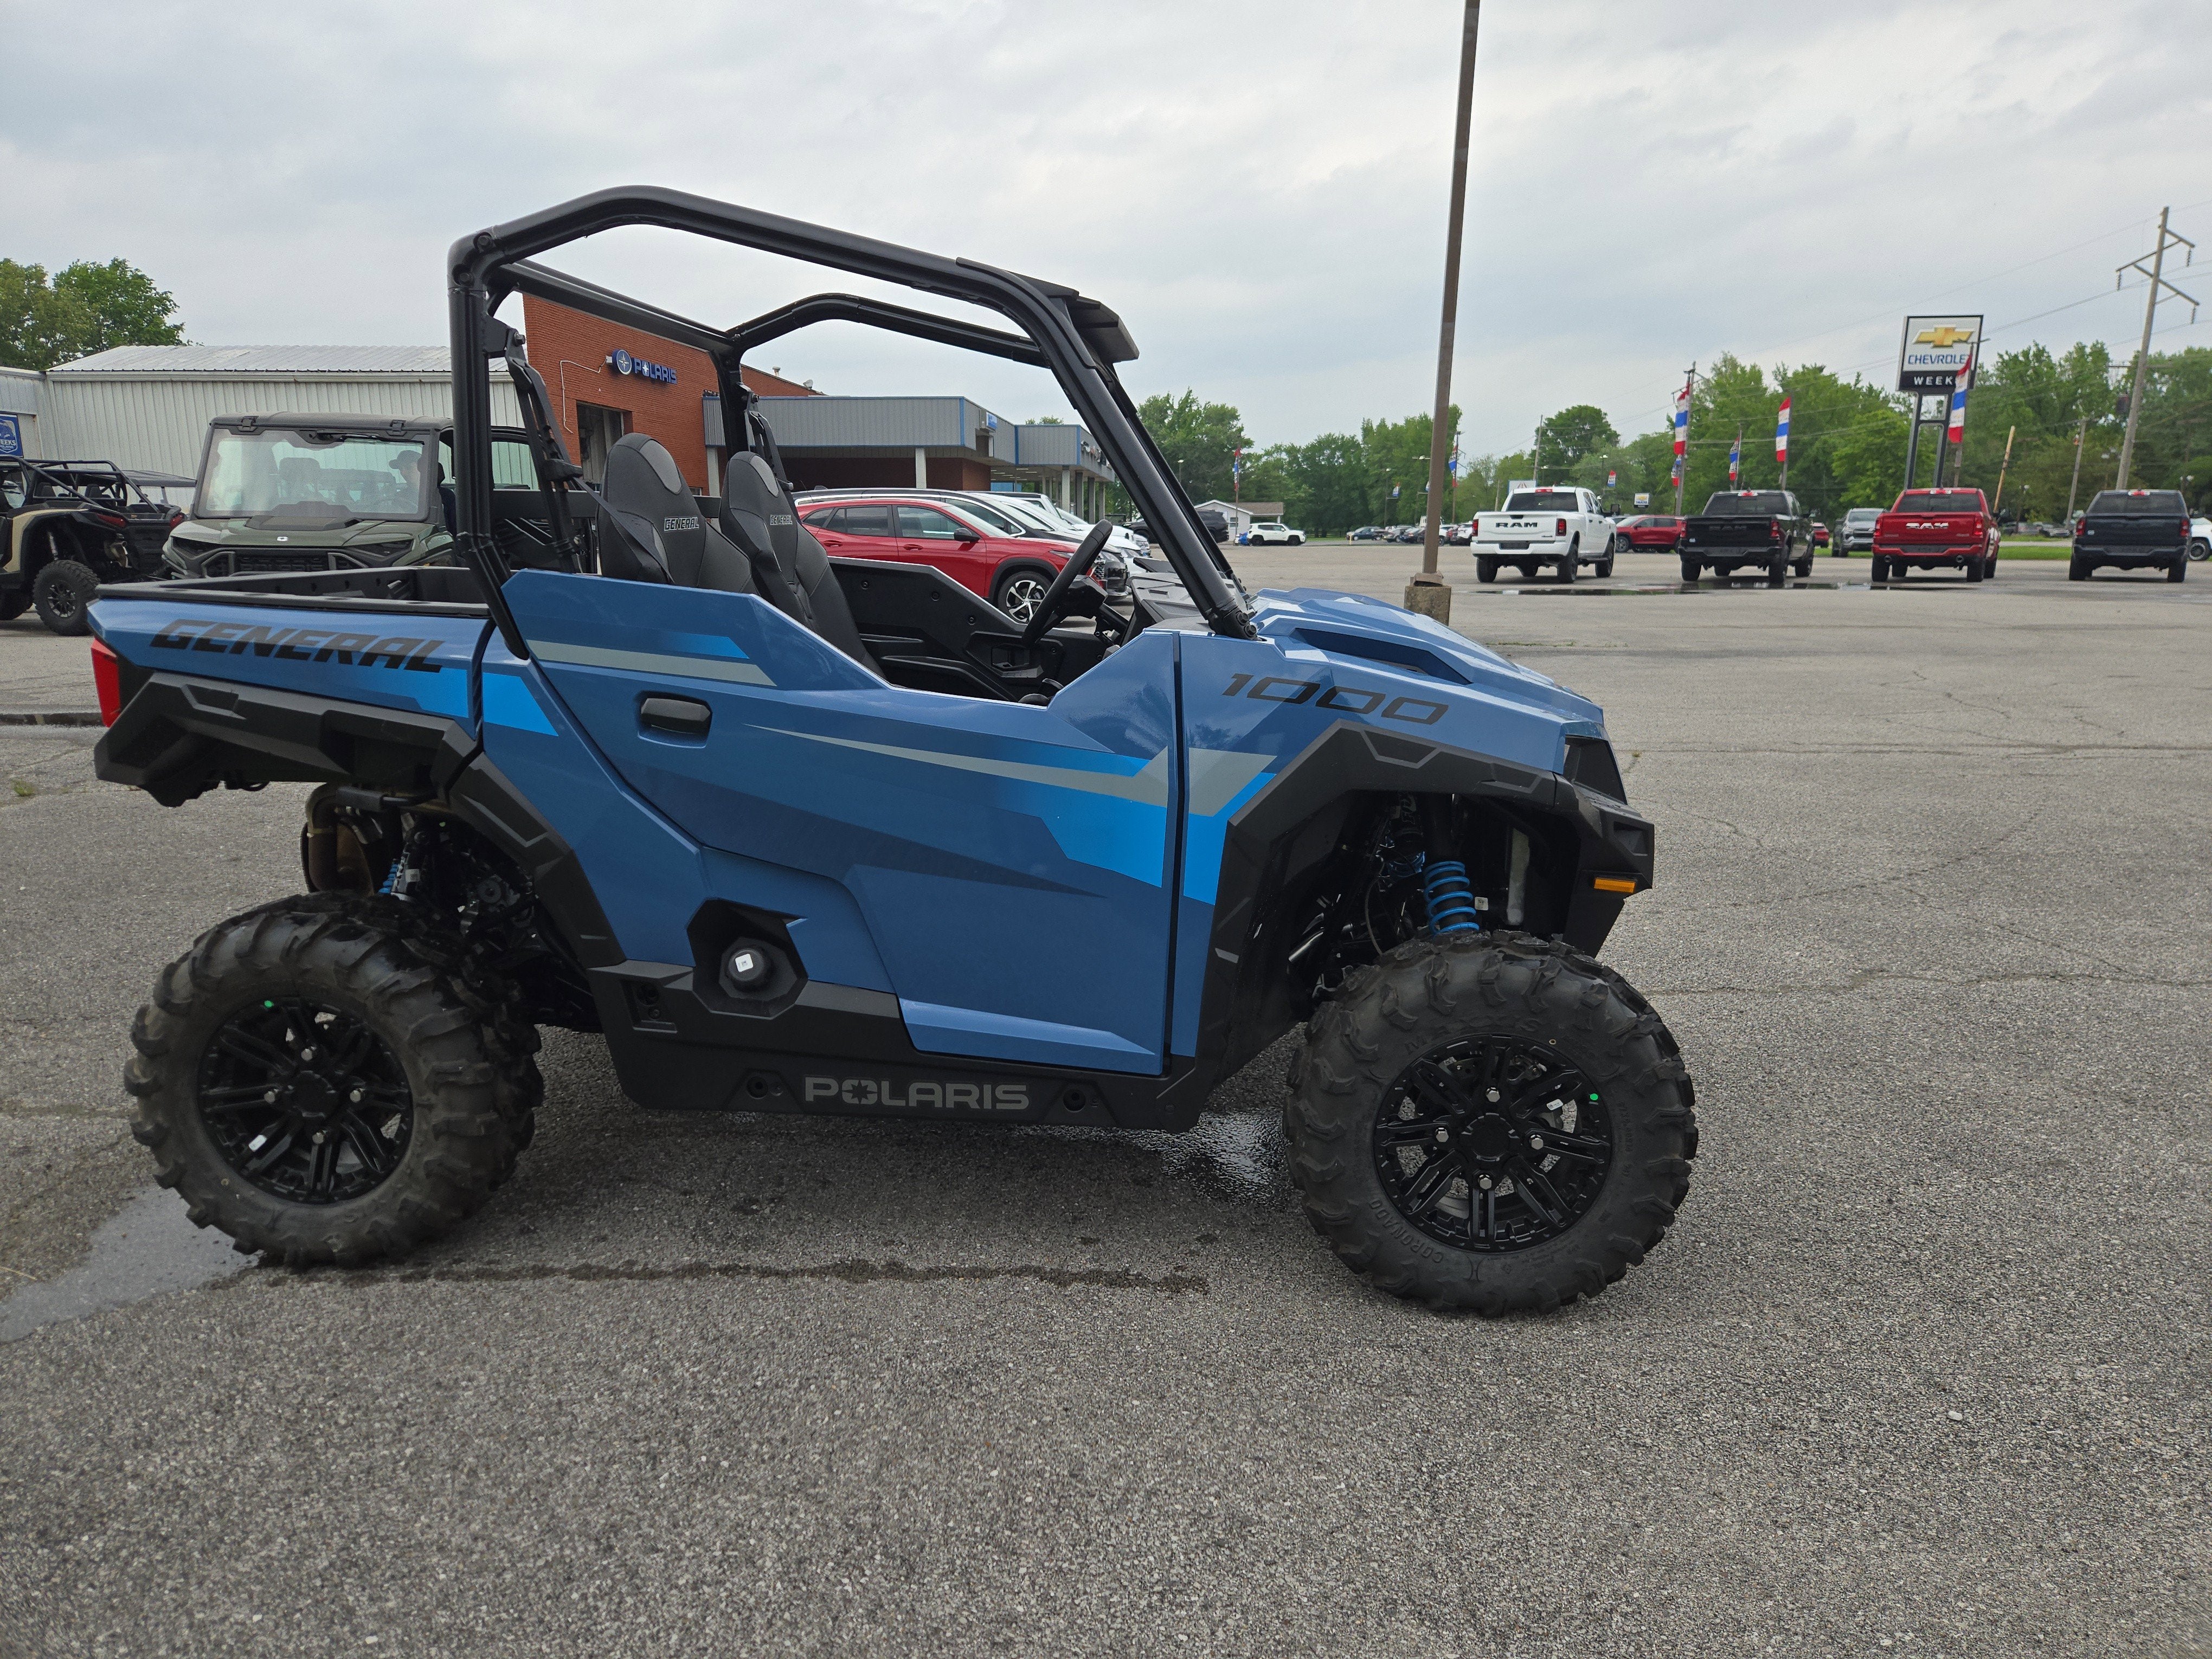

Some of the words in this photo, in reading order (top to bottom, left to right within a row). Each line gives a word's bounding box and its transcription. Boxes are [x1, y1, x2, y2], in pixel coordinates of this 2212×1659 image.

[633, 358, 677, 384] POLARIS
[1908, 353, 1968, 364] CHEVROLE
[1914, 376, 1953, 385] WEEK
[664, 517, 699, 531] GENERAL
[770, 515, 793, 525] GENERAL
[150, 619, 444, 673] GENERAL
[1222, 673, 1449, 725] 1000
[805, 1077, 1030, 1110] POLARIS
[1367, 1199, 1444, 1264] CORONADO
